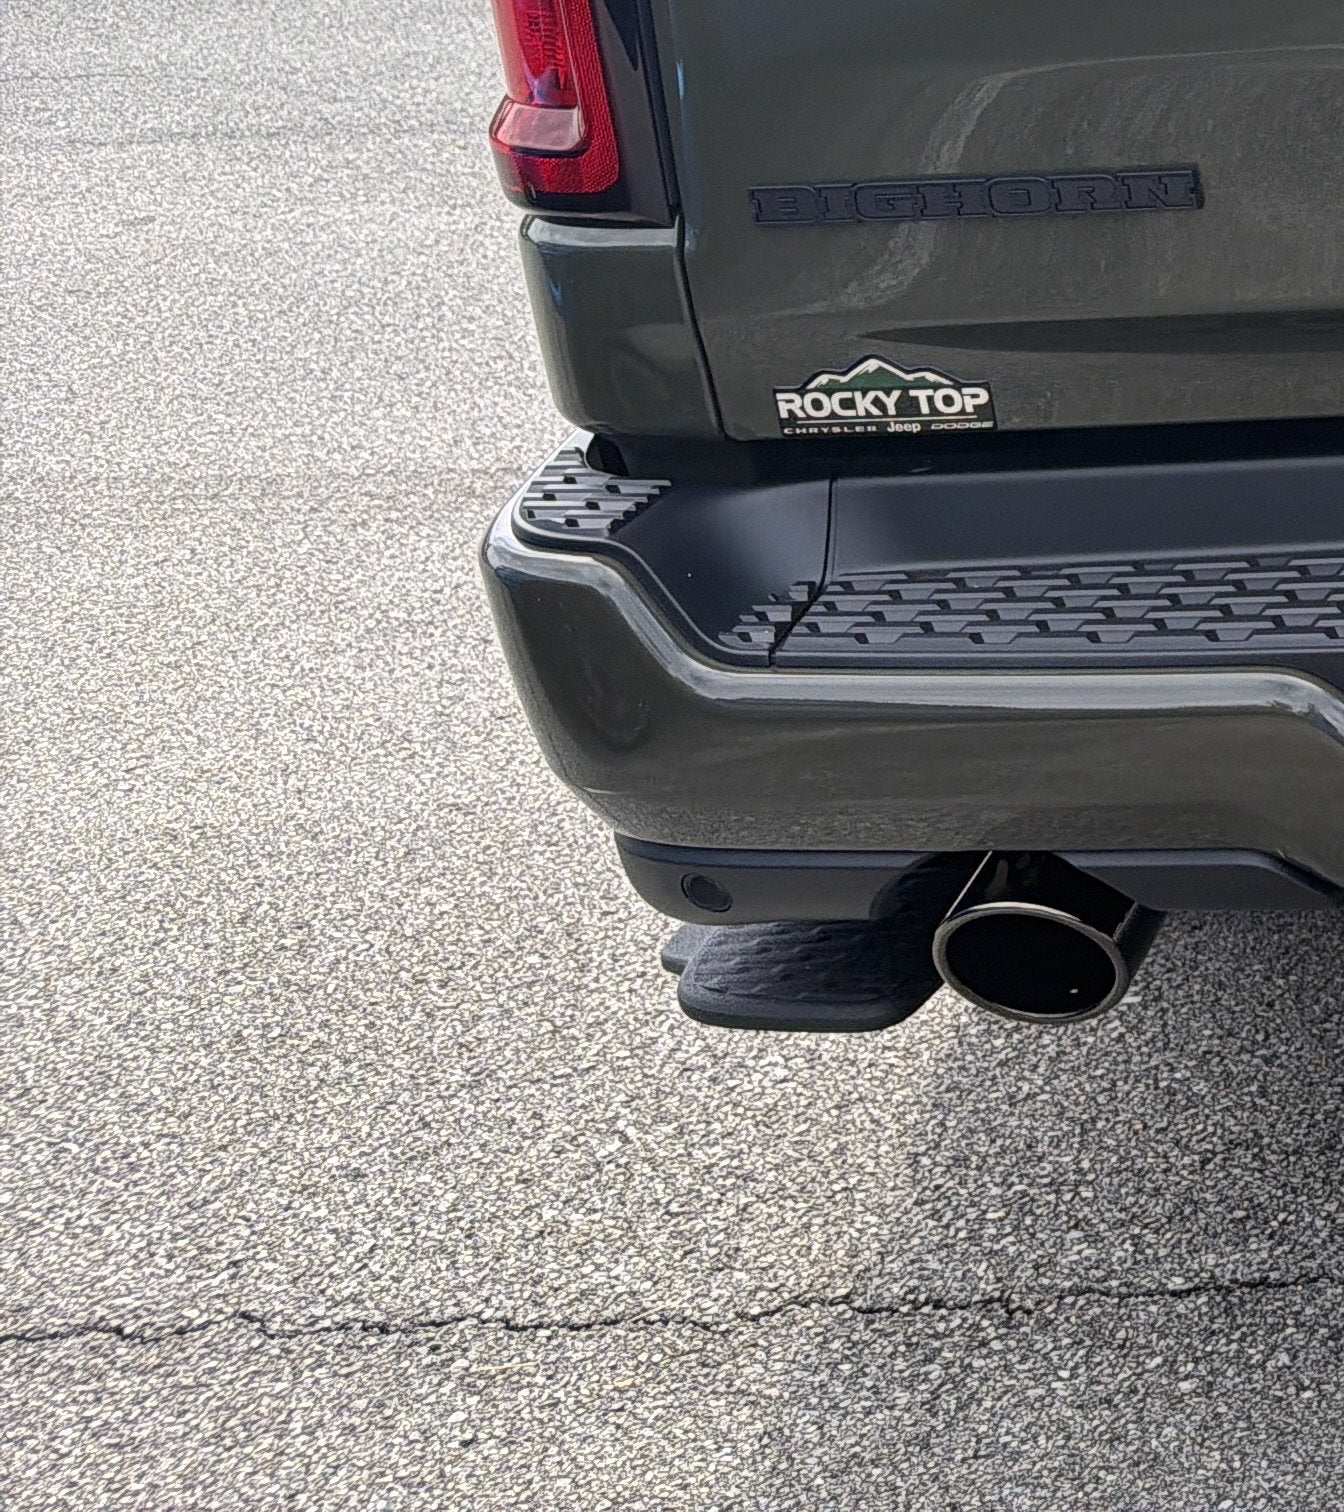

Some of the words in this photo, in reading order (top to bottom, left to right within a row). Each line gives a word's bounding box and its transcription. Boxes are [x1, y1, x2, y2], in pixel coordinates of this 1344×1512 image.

[748, 165, 1205, 225] BIGHORN
[776, 389, 902, 419] ROCKY
[909, 387, 990, 415] TOP
[783, 425, 878, 435] CHRYSLER
[887, 421, 922, 434] Jeep
[930, 420, 994, 430] DODGE
